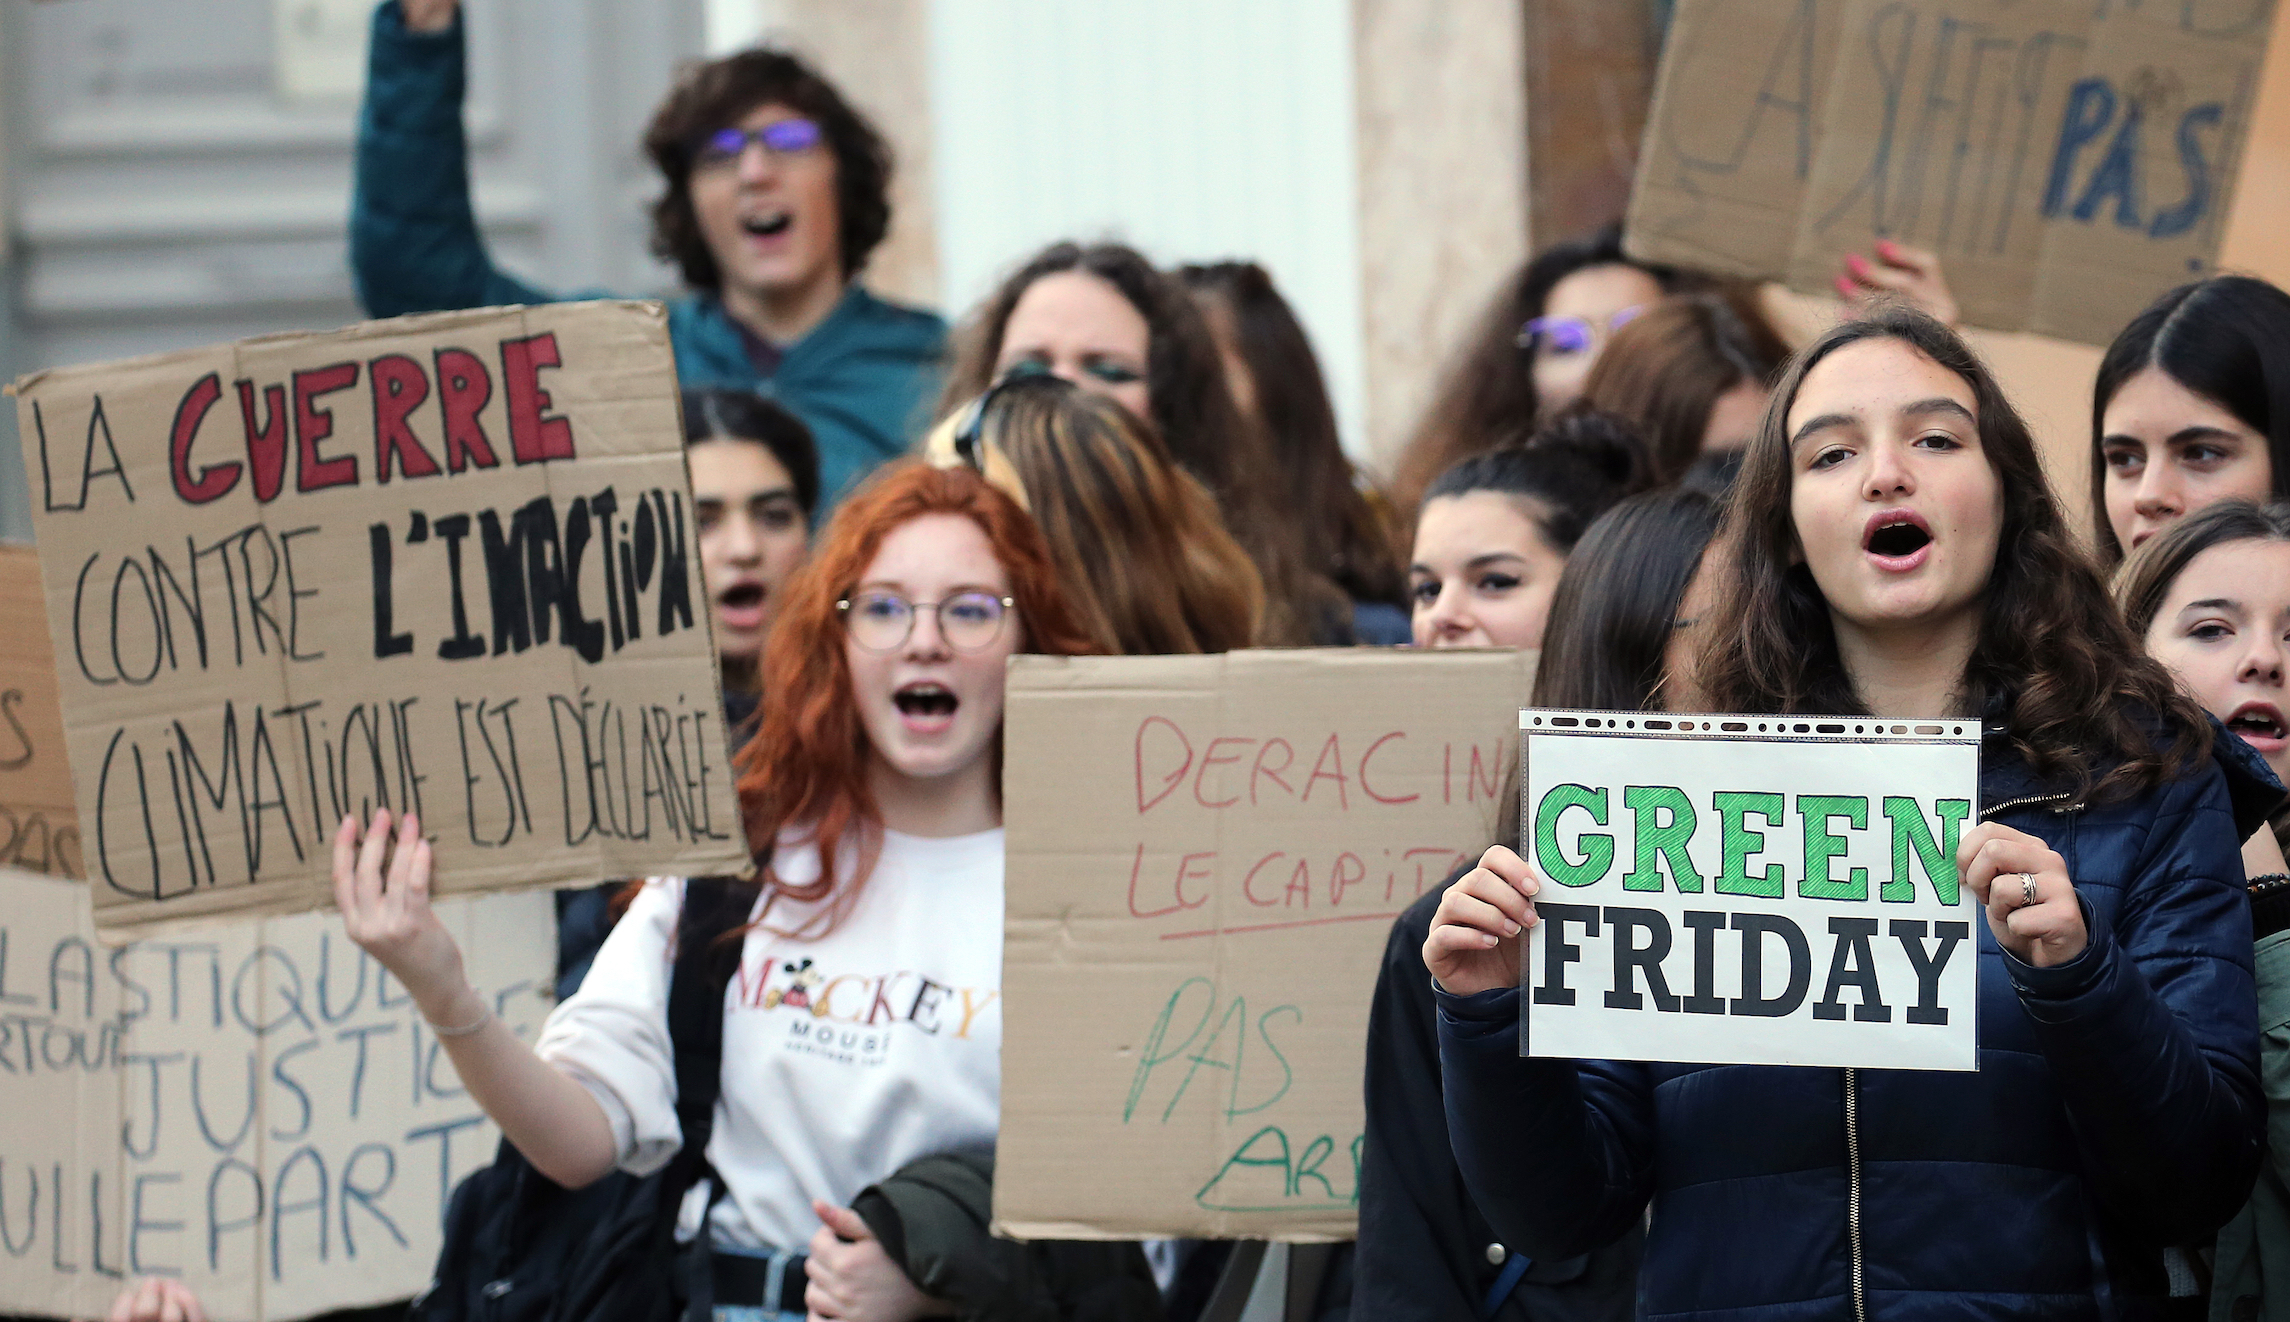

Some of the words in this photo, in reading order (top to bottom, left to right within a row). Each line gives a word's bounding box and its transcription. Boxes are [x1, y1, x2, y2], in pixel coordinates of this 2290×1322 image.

[32, 394, 135, 513] LA
[168, 332, 576, 504] GUERRE
[73, 526, 325, 686] CONTRE
[455, 696, 533, 848] EST
[547, 685, 731, 848] DÉCLARÉE
[1128, 842, 1219, 919] LE
[1534, 783, 1971, 907] GREEN
[1533, 902, 1969, 1026] FRIDAY
[1123, 975, 1303, 1125] PAS
